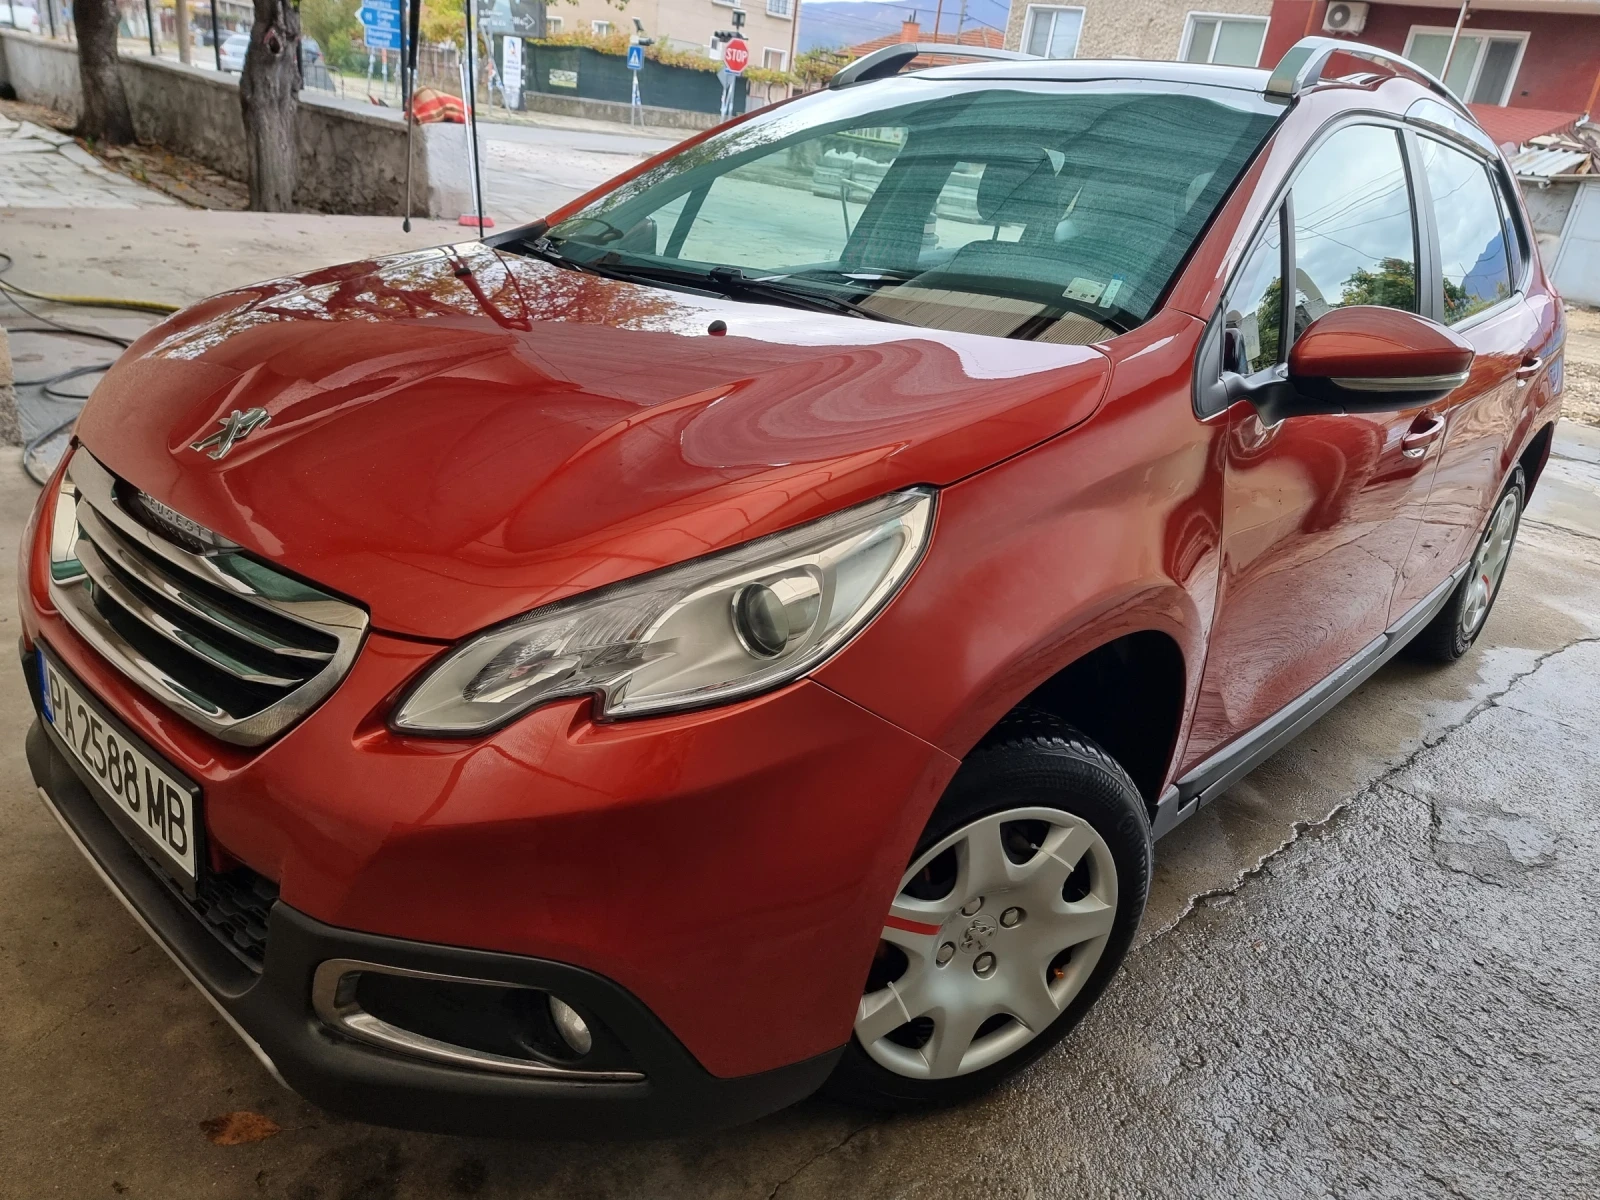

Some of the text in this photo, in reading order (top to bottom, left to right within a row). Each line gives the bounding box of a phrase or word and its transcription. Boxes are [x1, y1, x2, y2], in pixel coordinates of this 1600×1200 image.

[725, 48, 748, 63] STOP
[48, 667, 188, 856] PA 2588 MB
